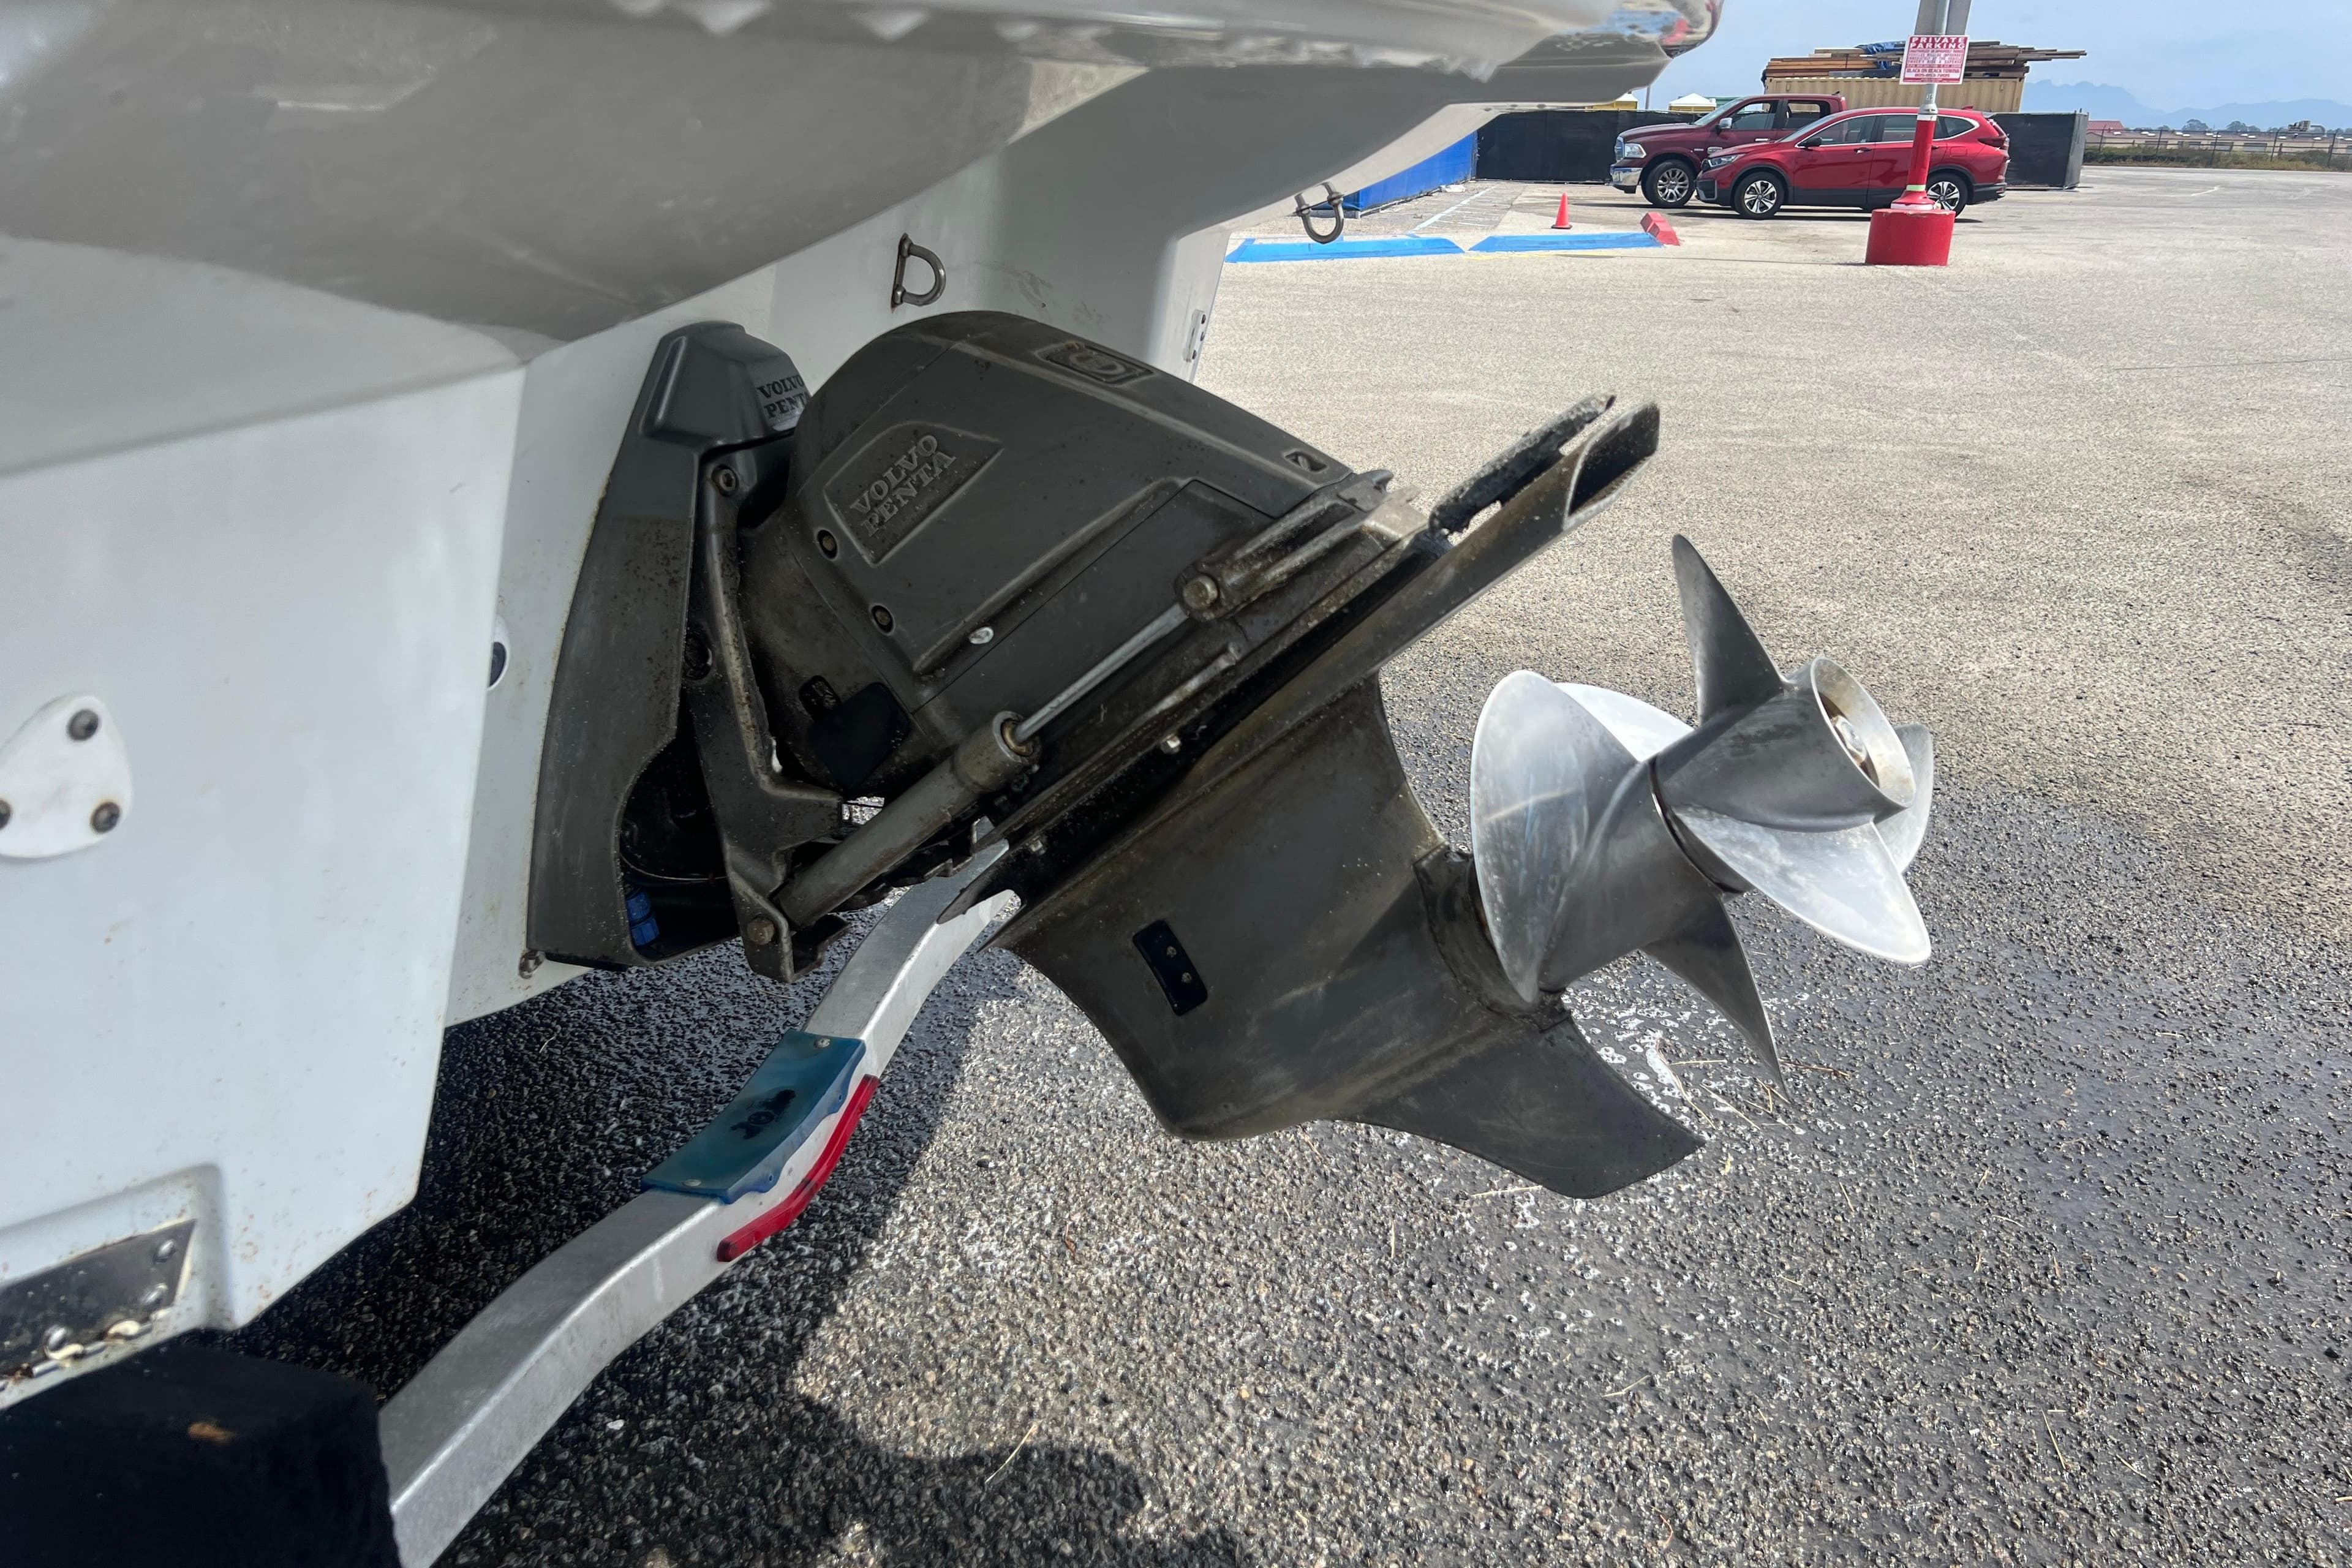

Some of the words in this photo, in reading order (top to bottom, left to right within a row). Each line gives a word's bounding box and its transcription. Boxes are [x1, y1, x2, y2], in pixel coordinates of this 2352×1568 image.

[757, 374, 805, 398] VOLVO
[850, 435, 937, 514] VOLVO
[861, 451, 957, 538] PENTA
